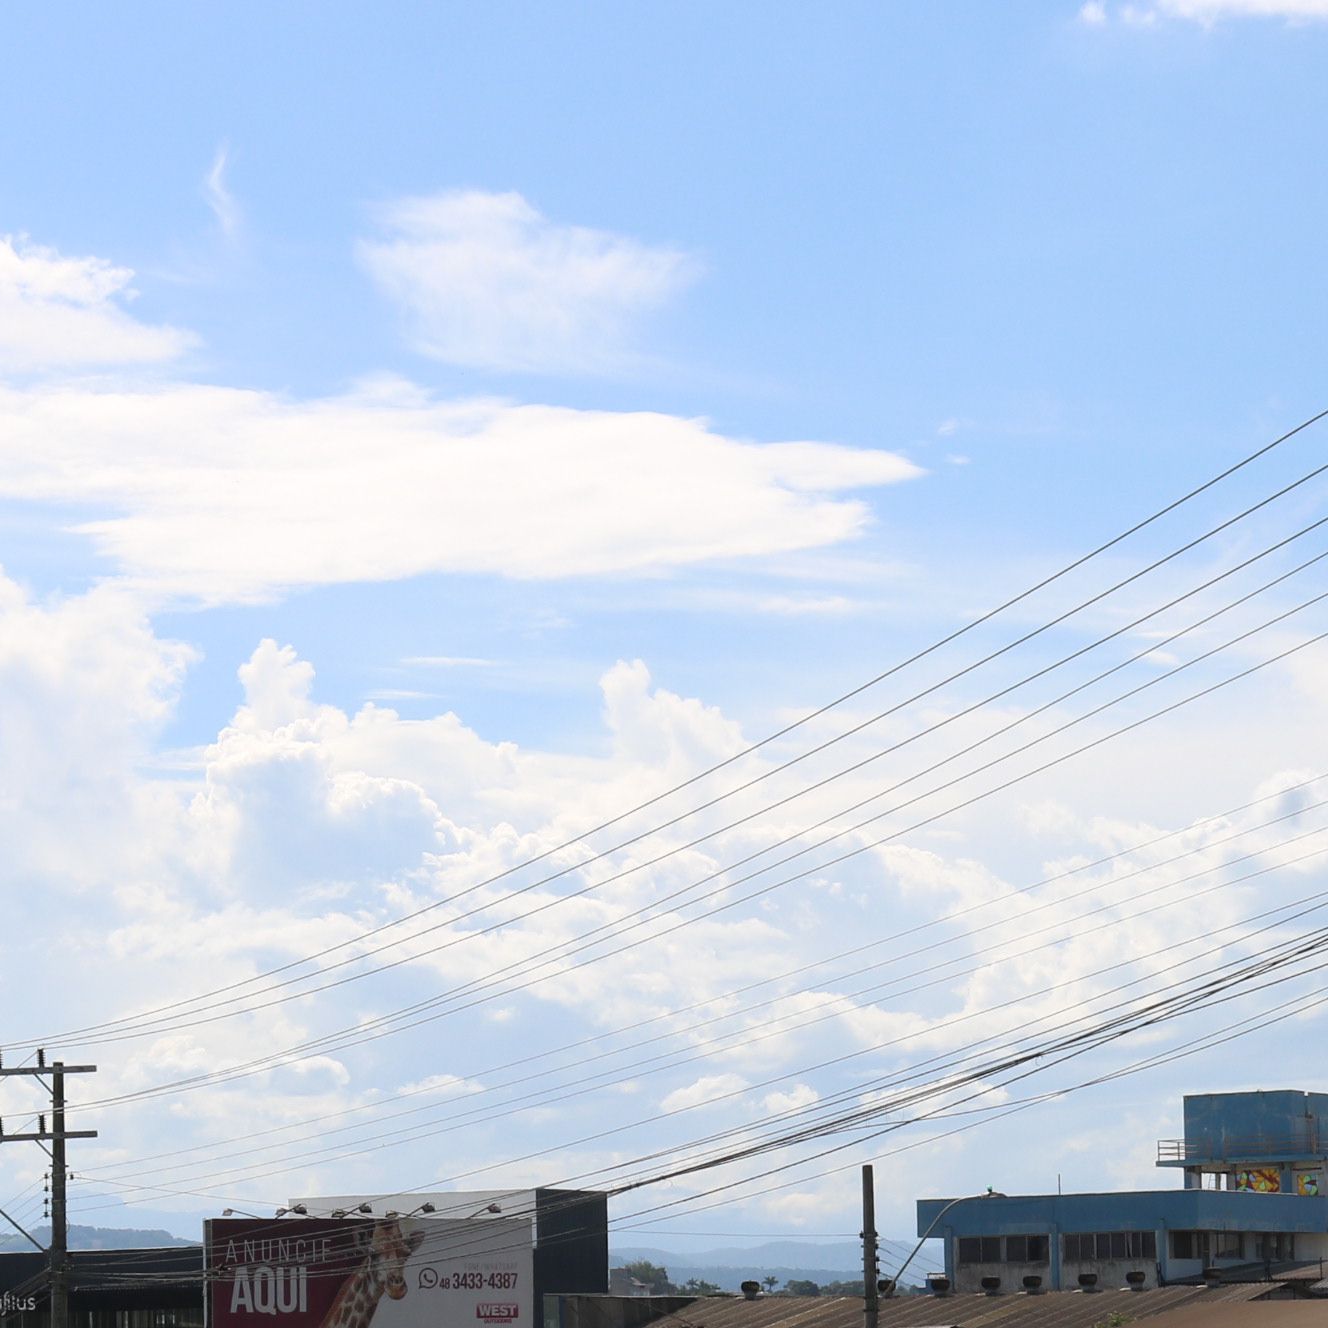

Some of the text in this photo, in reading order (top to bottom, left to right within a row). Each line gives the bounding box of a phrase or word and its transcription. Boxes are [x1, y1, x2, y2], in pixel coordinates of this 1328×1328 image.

[225, 1239, 331, 1262] ANUNCIE
[230, 1266, 307, 1315] AQUI
[439, 1272, 518, 1290] 48 3433-4387
[478, 1304, 517, 1316] WEST
